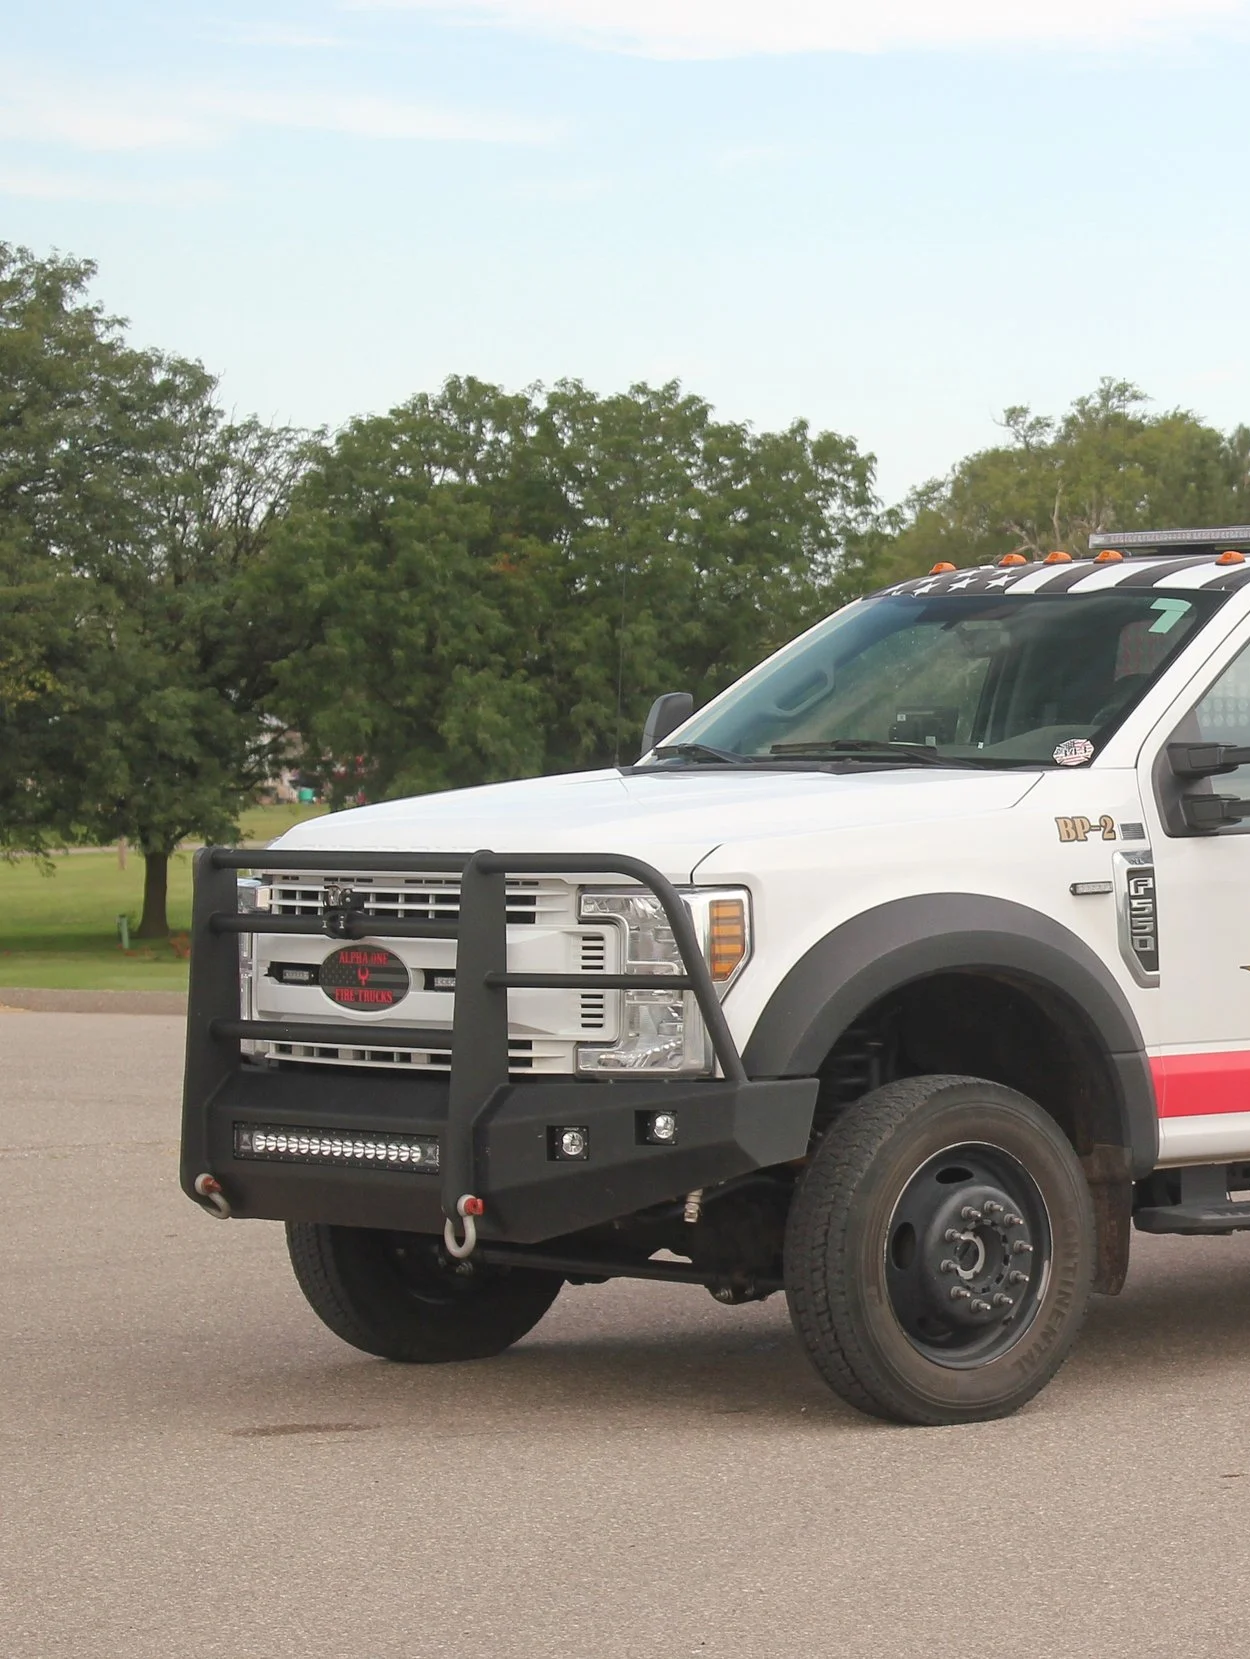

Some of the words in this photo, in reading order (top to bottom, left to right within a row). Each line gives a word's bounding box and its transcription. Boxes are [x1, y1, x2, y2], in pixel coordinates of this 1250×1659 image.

[1055, 815, 1117, 842] BP-2
[339, 951, 368, 965] ALPHA
[371, 952, 389, 965] ONE
[335, 988, 355, 1002] FIRE
[358, 989, 393, 1004] TRUCKS
